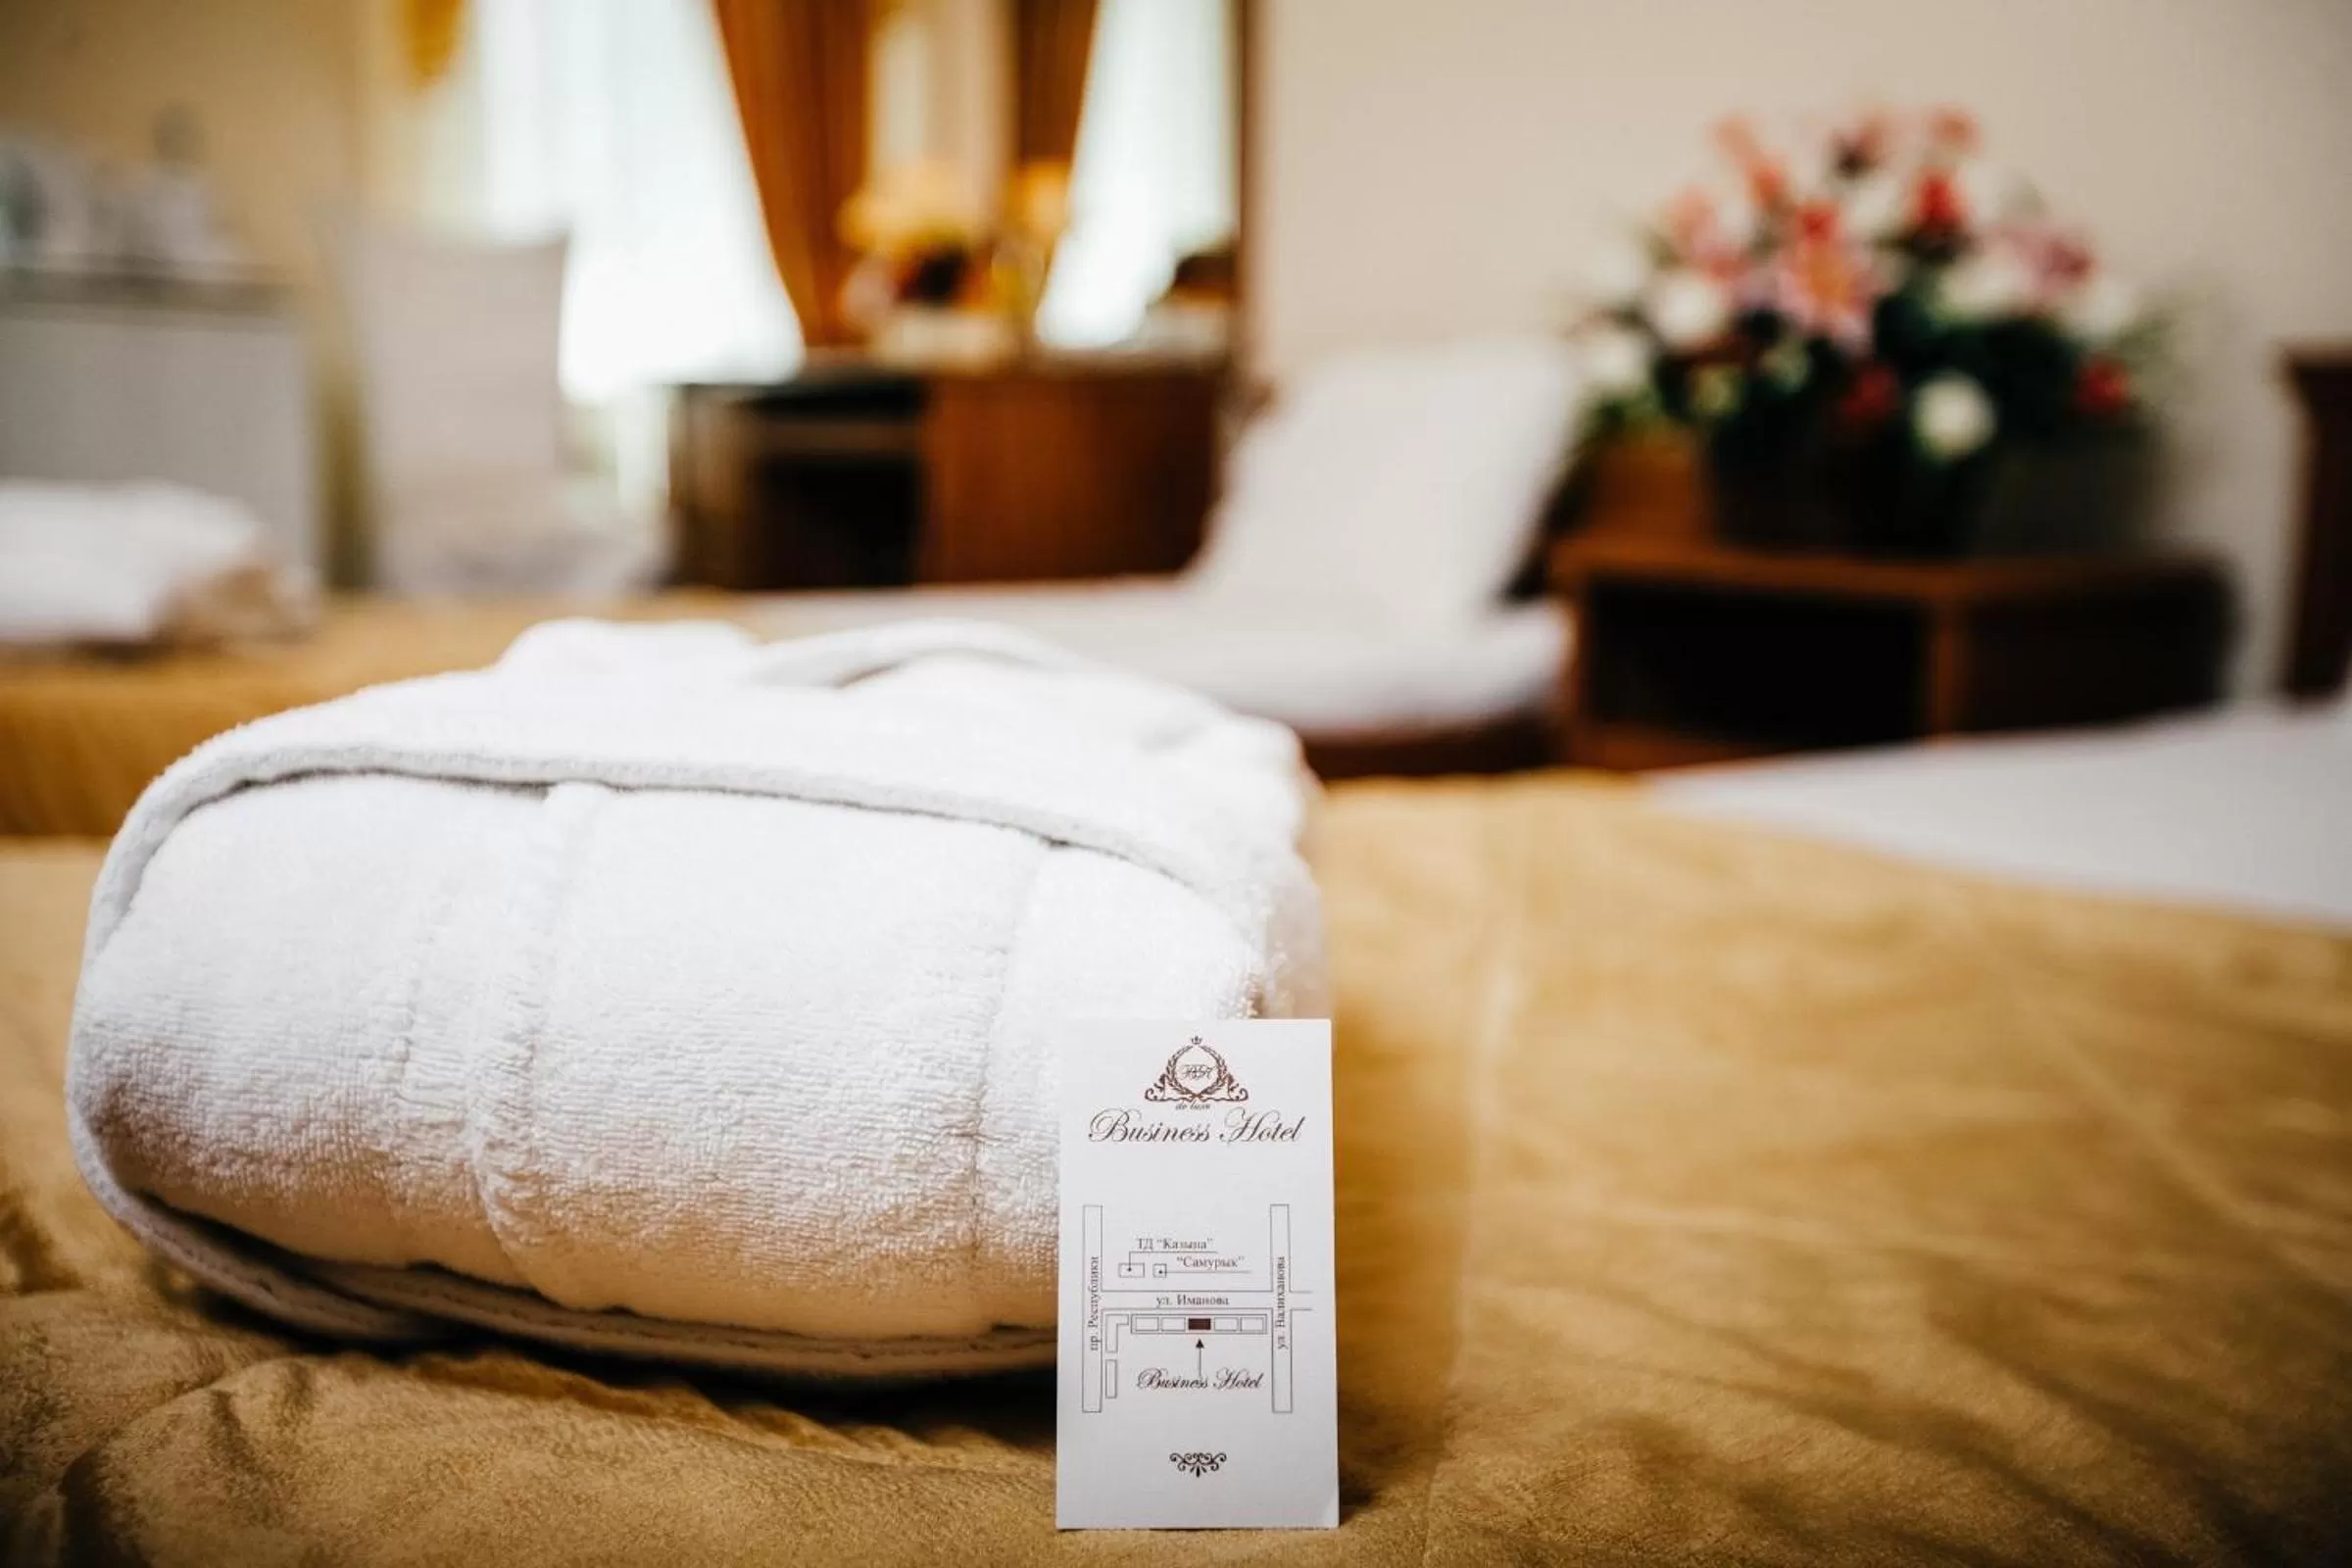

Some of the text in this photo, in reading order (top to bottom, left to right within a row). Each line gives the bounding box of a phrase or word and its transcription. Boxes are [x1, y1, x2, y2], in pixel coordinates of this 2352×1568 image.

[1088, 1106, 1305, 1145] Business Hotel
[1137, 1238, 1153, 1250] ТД
[1087, 1256, 1102, 1329] Республики
[1155, 1294, 1230, 1308] ул. Иманова
[1274, 1256, 1286, 1328] Валиханова
[1136, 1367, 1264, 1390] Business Hotel
